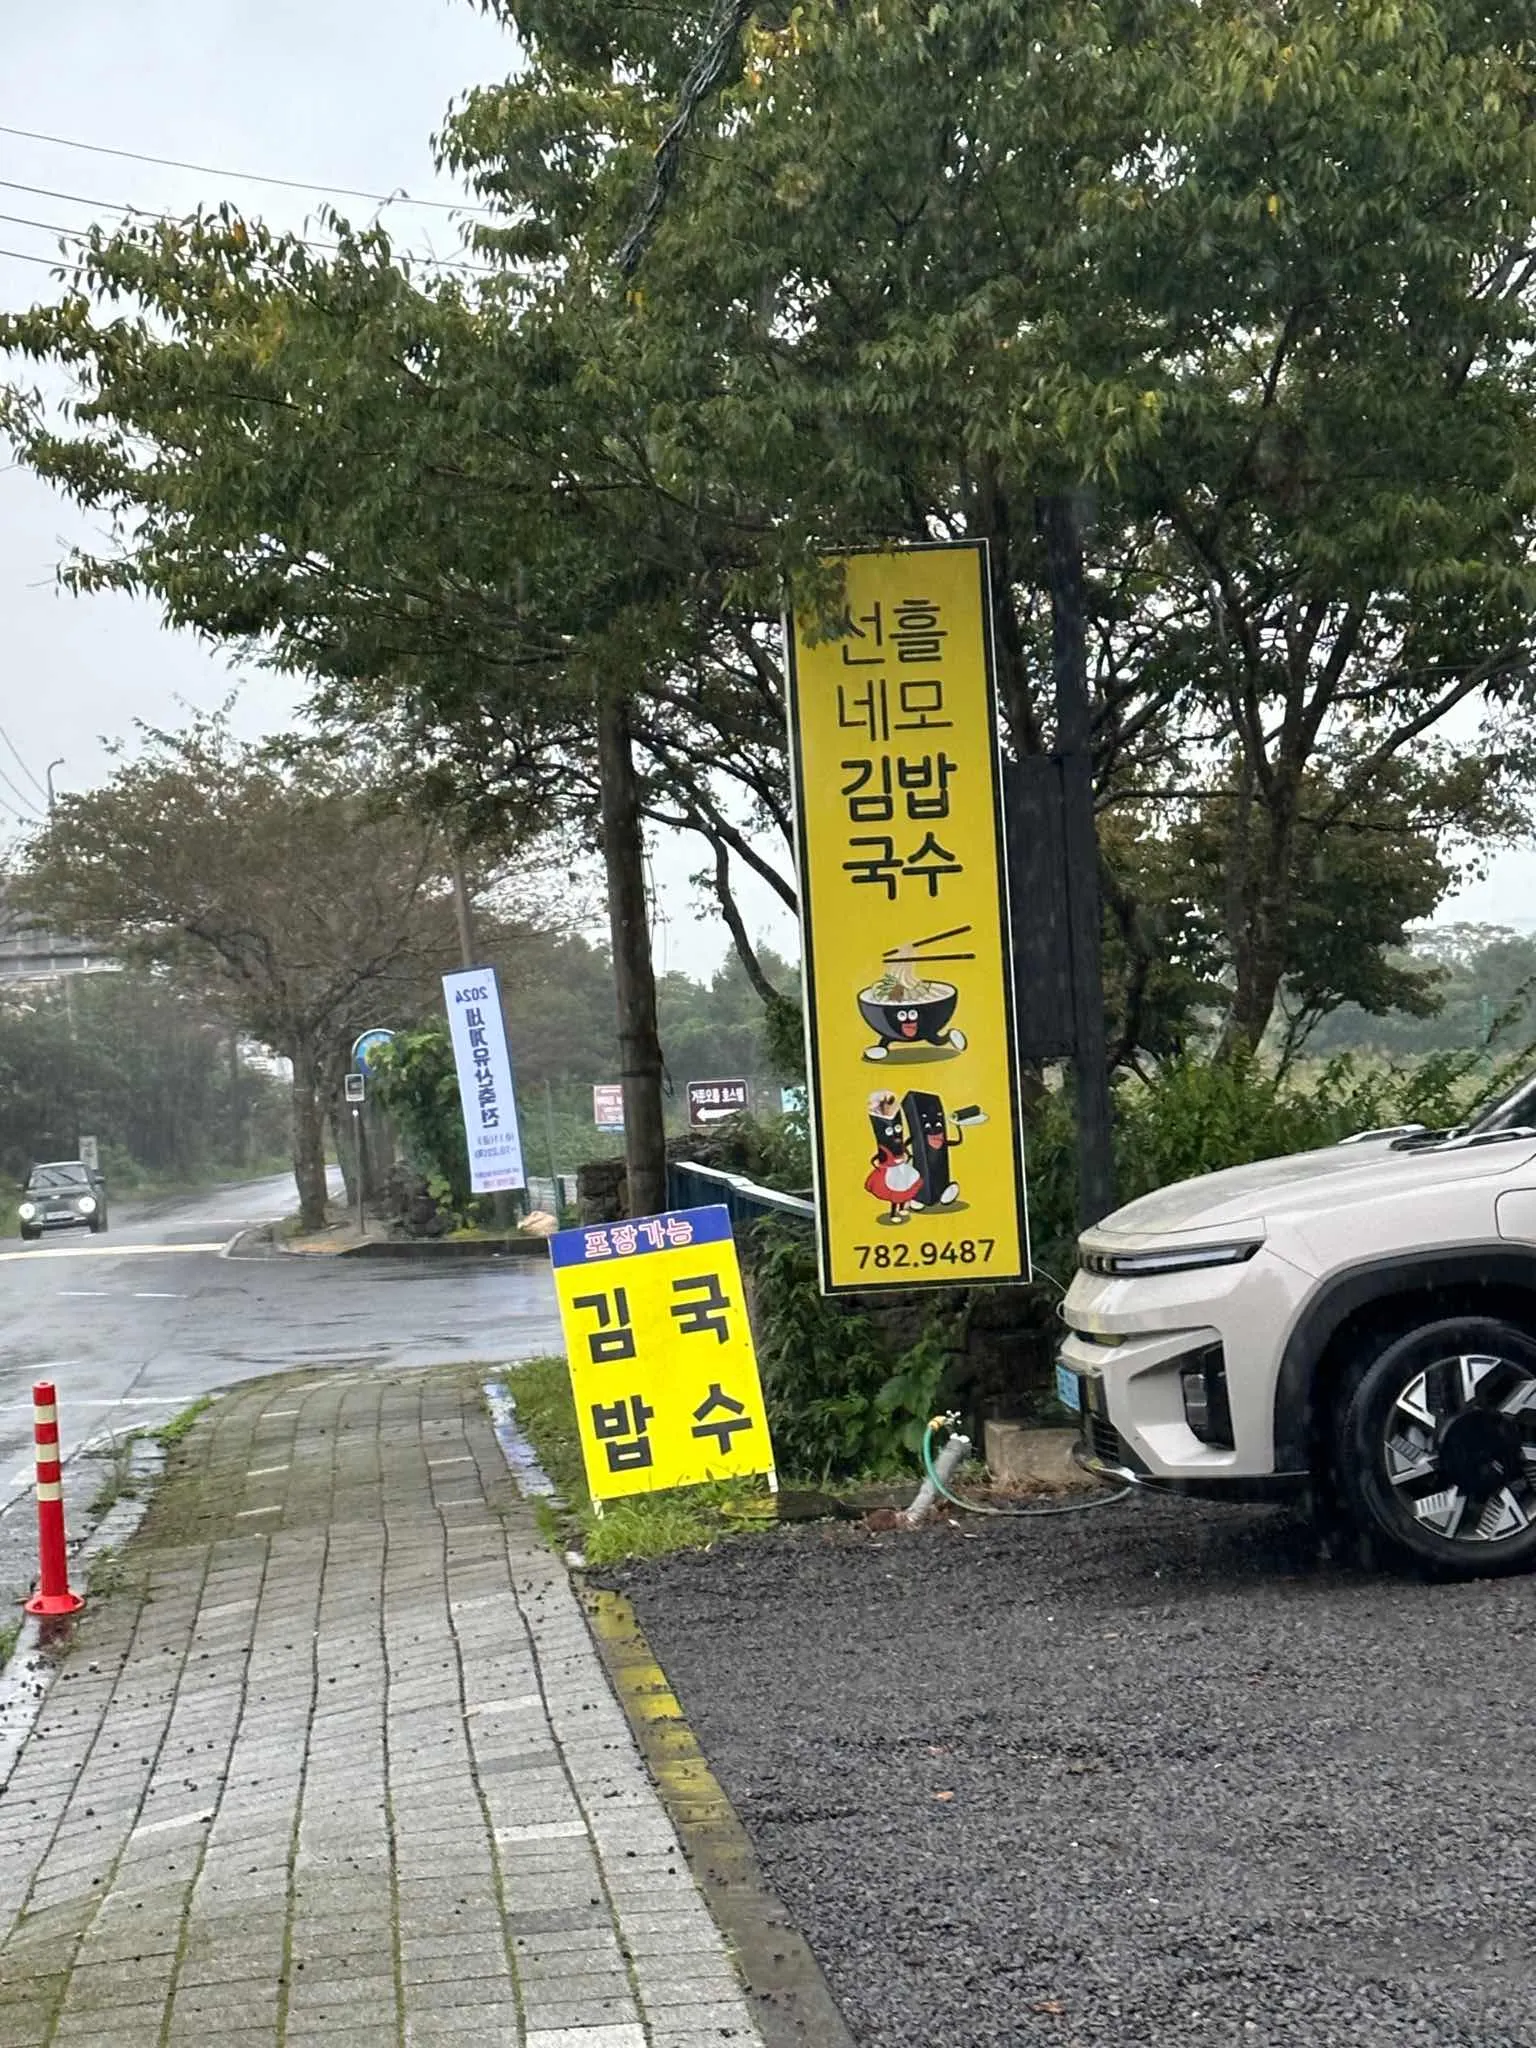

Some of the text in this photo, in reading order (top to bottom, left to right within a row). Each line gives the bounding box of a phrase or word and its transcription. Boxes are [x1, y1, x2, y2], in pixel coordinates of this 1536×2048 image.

[842, 599, 948, 665] 선흘
[837, 679, 953, 741] 네모
[841, 752, 957, 822] 김밥
[842, 831, 963, 900] 국수
[854, 1239, 996, 1270] 782.9487
